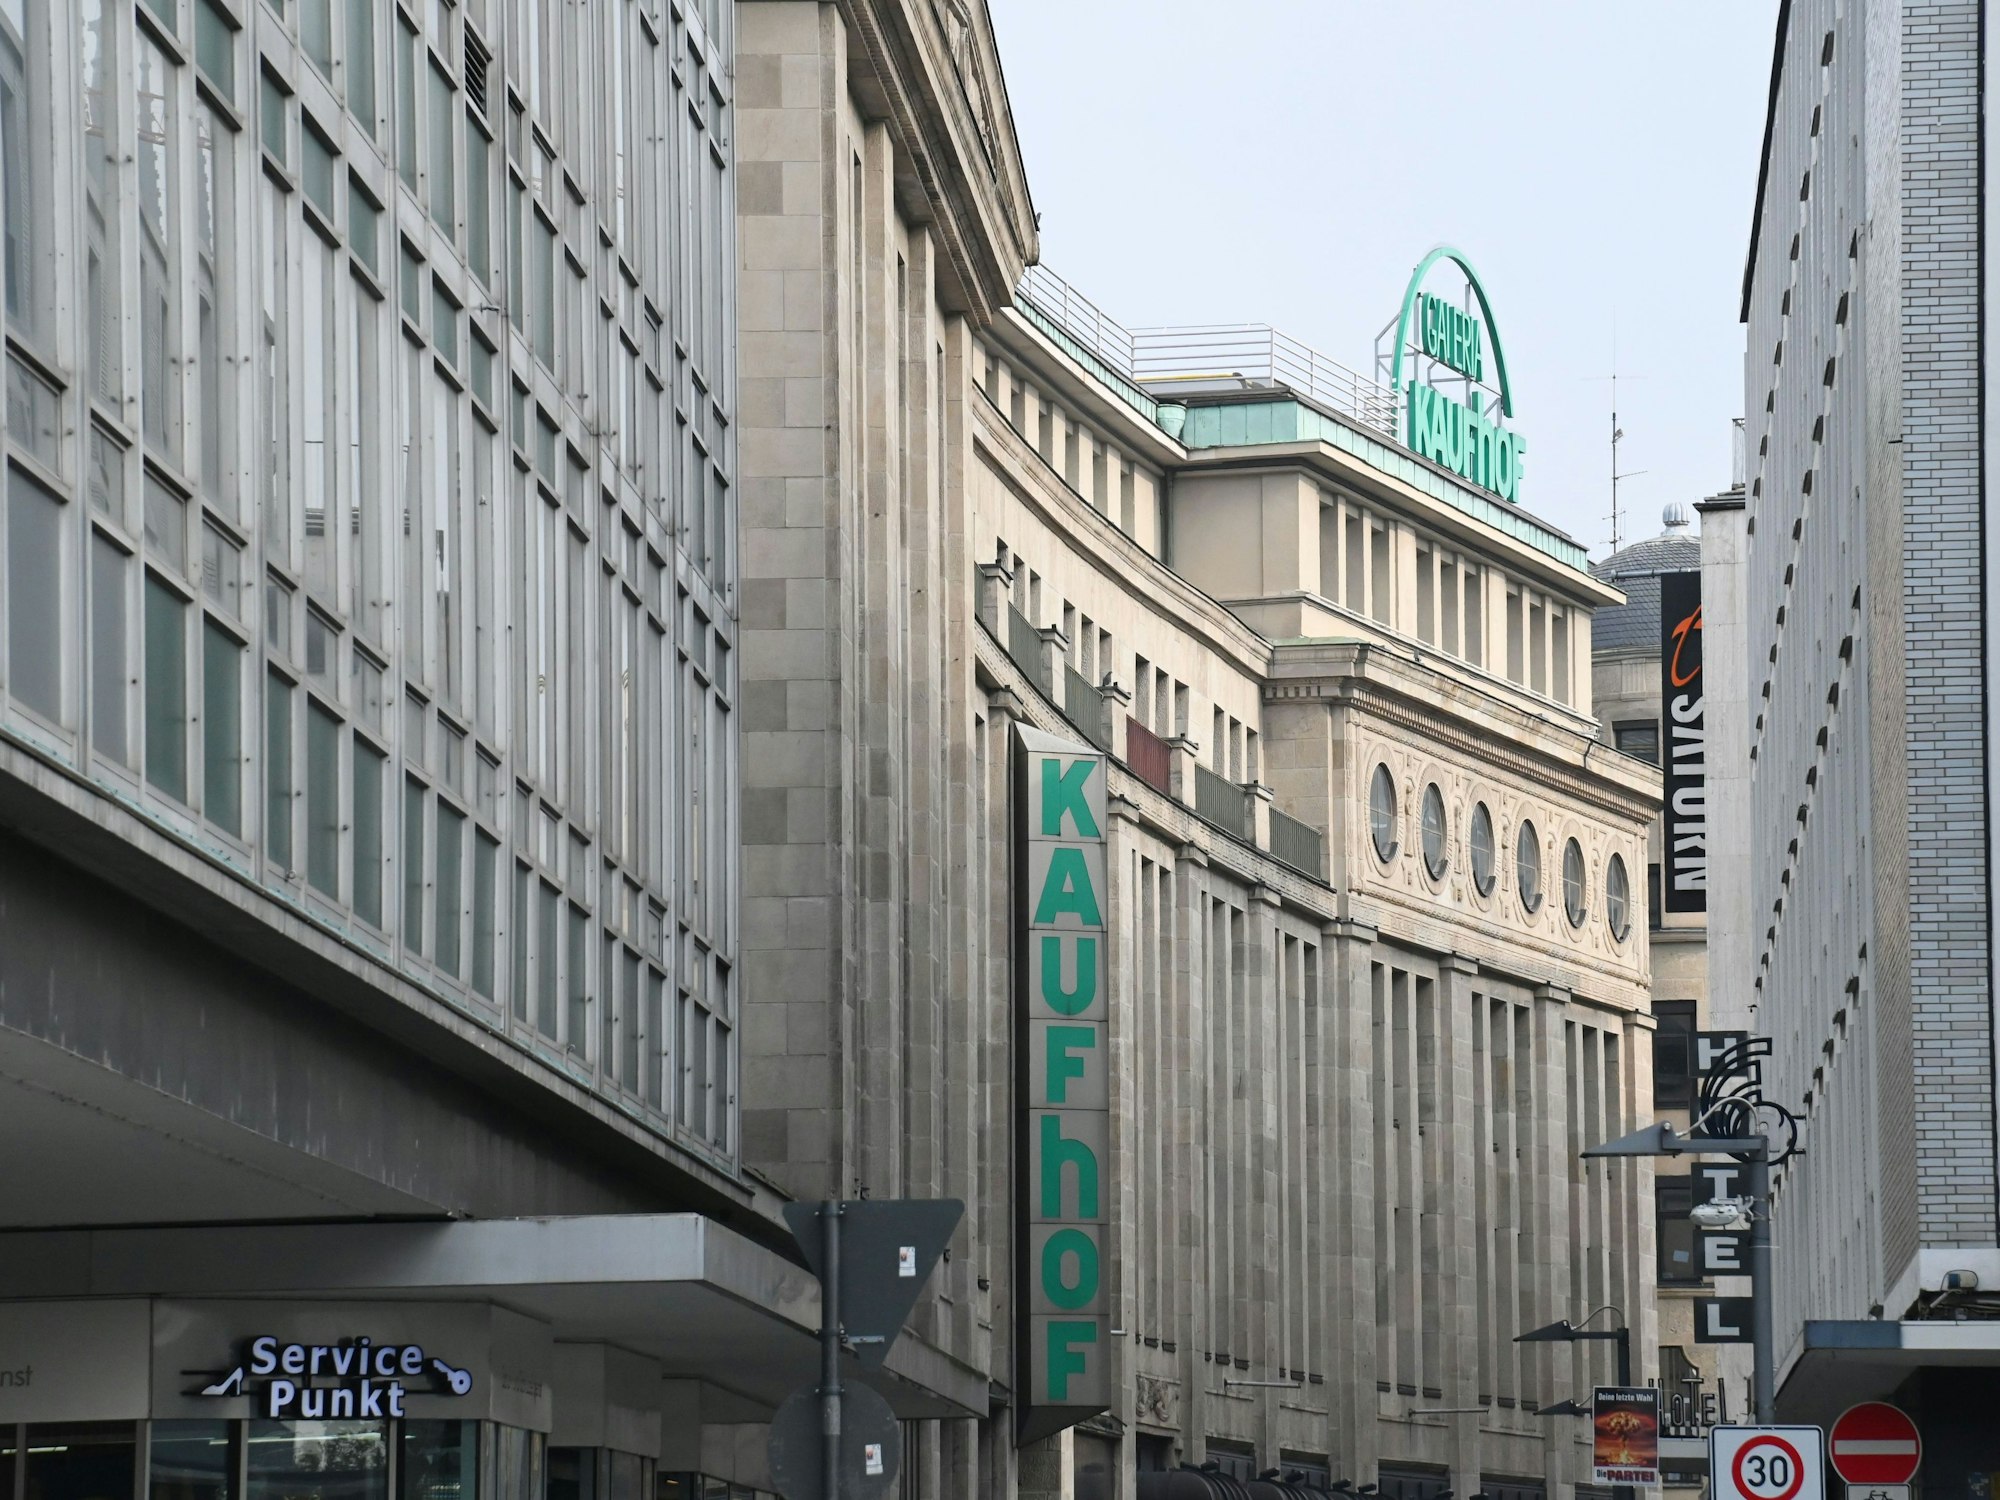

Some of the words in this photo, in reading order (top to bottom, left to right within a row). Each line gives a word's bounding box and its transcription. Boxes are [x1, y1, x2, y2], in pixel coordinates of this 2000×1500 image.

[1421, 291, 1483, 383] GALERIA
[1697, 1037, 1741, 1337] HTEL
[251, 1336, 424, 1377] Service
[268, 1379, 405, 1418] Punkt
[1598, 1392, 1615, 1401] Deine
[1616, 1392, 1635, 1402] letzte
[1636, 1393, 1654, 1402] Wahl
[1596, 1468, 1606, 1478] Die
[1607, 1469, 1655, 1483] PARTEI
[1747, 1455, 1789, 1488] 30
